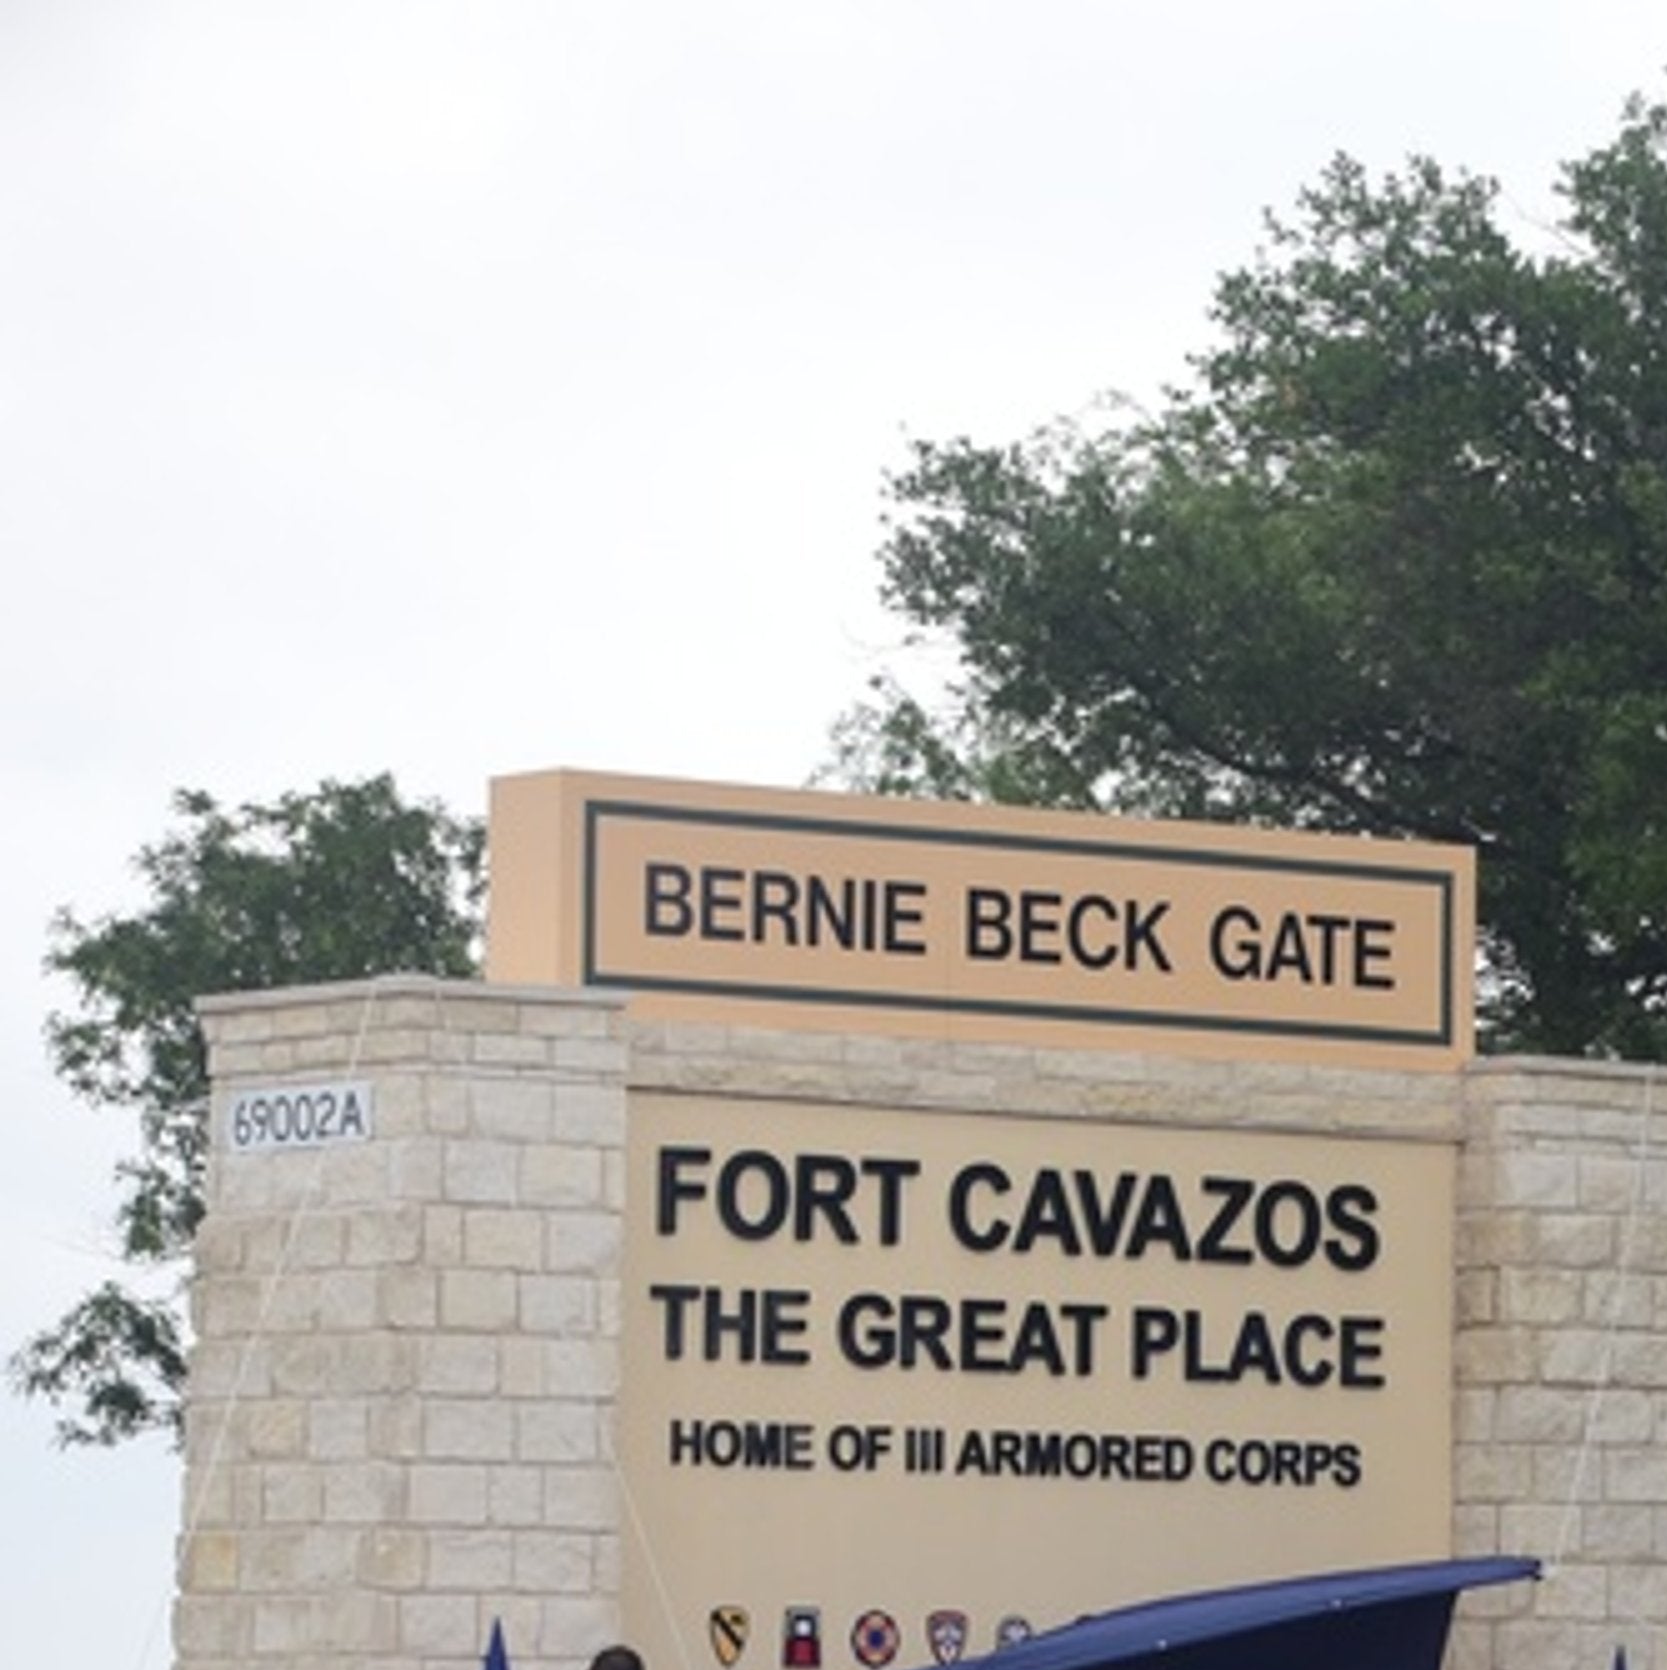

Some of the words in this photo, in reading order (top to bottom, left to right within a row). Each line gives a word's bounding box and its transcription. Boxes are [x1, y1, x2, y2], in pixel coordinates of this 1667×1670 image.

[644, 862, 928, 956] BERNIE
[965, 886, 1173, 973] BECK
[1208, 904, 1397, 991] GATE
[233, 1091, 366, 1146] 69002A
[656, 1146, 921, 1247] FORT
[948, 1162, 1381, 1273] CAVAZOS
[649, 1284, 812, 1366] THE
[836, 1292, 1111, 1379] GREAT
[1130, 1306, 1387, 1391] PLACE
[669, 1418, 815, 1471] HOME
[827, 1425, 893, 1473] OF
[904, 1427, 946, 1474] III
[953, 1428, 1195, 1484] ARMORED
[1204, 1438, 1362, 1489] CORPS
